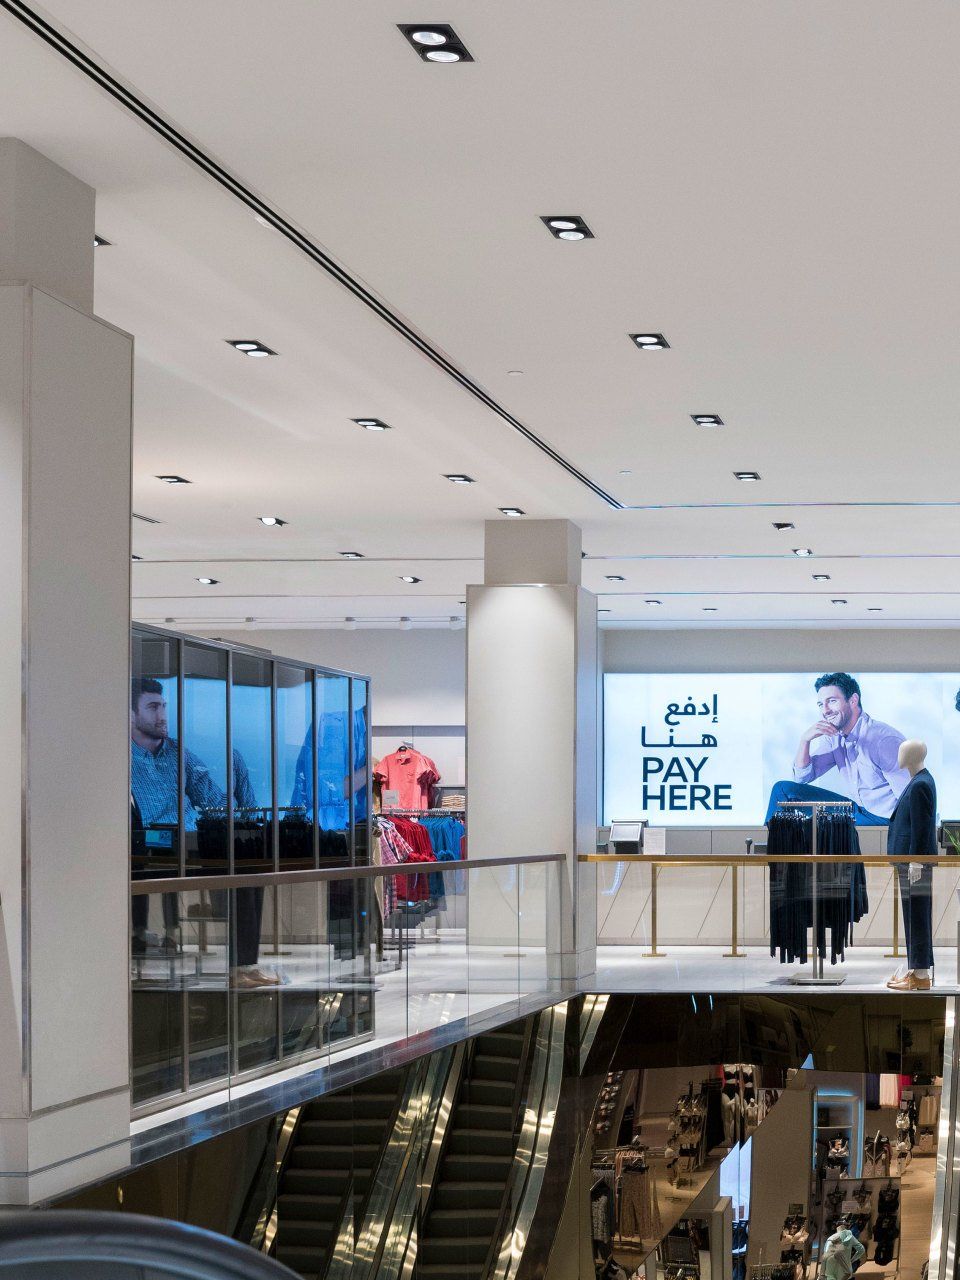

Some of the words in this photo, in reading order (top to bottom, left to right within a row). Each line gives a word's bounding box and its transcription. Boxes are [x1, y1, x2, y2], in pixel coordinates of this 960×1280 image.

[664, 693, 719, 726] إدفع
[642, 756, 709, 783] PAY
[642, 784, 733, 811] HERE
